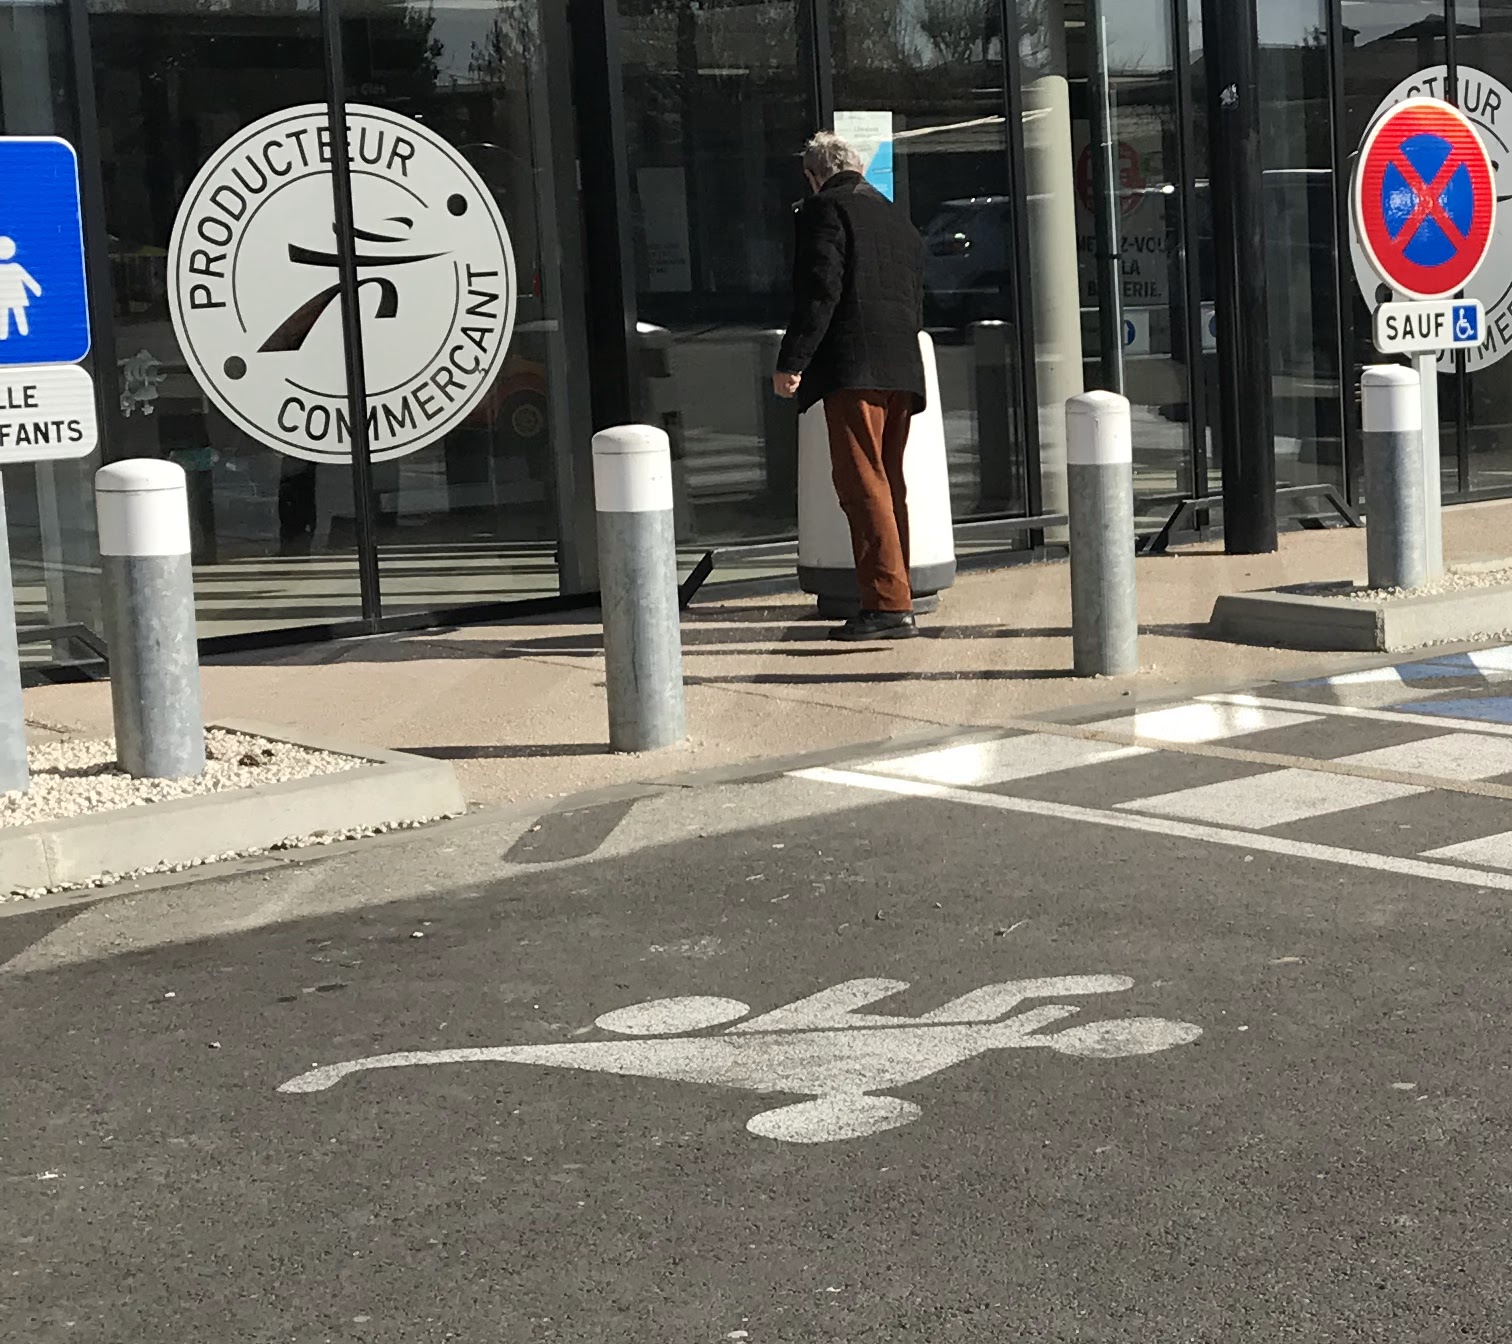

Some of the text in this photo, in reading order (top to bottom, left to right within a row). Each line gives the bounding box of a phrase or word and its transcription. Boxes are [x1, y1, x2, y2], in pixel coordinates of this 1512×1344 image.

[188, 126, 416, 310] PRODUCTEUR
[276, 262, 500, 444] COMMERÇANT
[1385, 312, 1446, 341] SAUF
